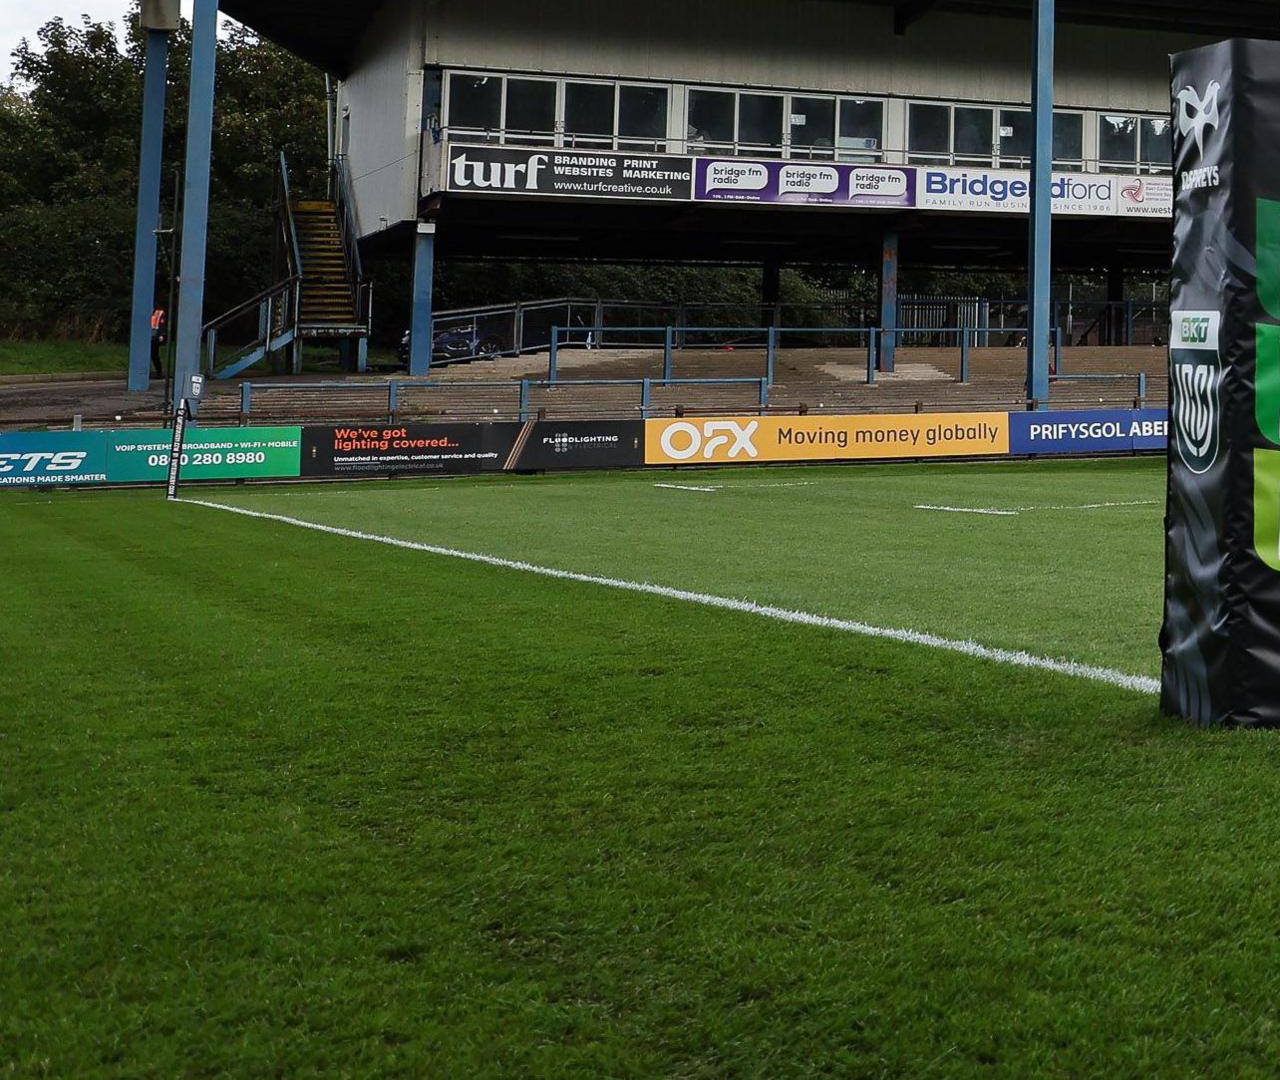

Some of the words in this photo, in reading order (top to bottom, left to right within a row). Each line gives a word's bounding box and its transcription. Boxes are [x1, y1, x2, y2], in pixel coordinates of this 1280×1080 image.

[554, 155, 617, 168] BRANDING
[623, 159, 659, 169] PRINT
[451, 153, 549, 191] turf
[553, 166, 614, 178] WEBSITES
[622, 169, 691, 182] MARKETING
[713, 167, 747, 180] bridge
[747, 168, 763, 177] fm
[785, 171, 817, 183] bridge
[817, 172, 833, 181] fm
[1181, 165, 1220, 191] OSPREYS
[712, 176, 739, 185] radio
[785, 179, 811, 188] radio
[855, 173, 886, 185] bridge
[887, 175, 901, 184] fm
[553, 181, 672, 196] www.turfcreative.co.uk
[855, 182, 880, 190] radio
[925, 171, 1112, 202] Bridgedford
[925, 199, 964, 207] FAMILY
[969, 200, 991, 208] RUN
[996, 201, 1030, 209] BUSIN
[1181, 322, 1209, 339] BKT
[335, 428, 378, 439] We've
[383, 428, 407, 440] got
[1029, 421, 1127, 441] PRIFYSGOL
[1130, 420, 1169, 438] ABE
[181, 442, 233, 450] BROADBAND
[239, 441, 261, 449] WI-FI
[267, 440, 298, 448] MOBILE
[334, 438, 389, 451] lighting
[392, 437, 459, 449] covered...
[543, 435, 619, 444] FLOODLIGHTING
[661, 420, 759, 459] OFX
[777, 427, 848, 448] Moving
[855, 428, 919, 445] money
[926, 422, 999, 443] globally
[148, 453, 188, 467] 080
[192, 452, 223, 465] 280
[226, 452, 266, 464] 8980
[334, 455, 373, 463] Unmatched
[379, 455, 410, 463] expertise,
[477, 452, 498, 460] quality
[64, 473, 107, 482] SMARTER
